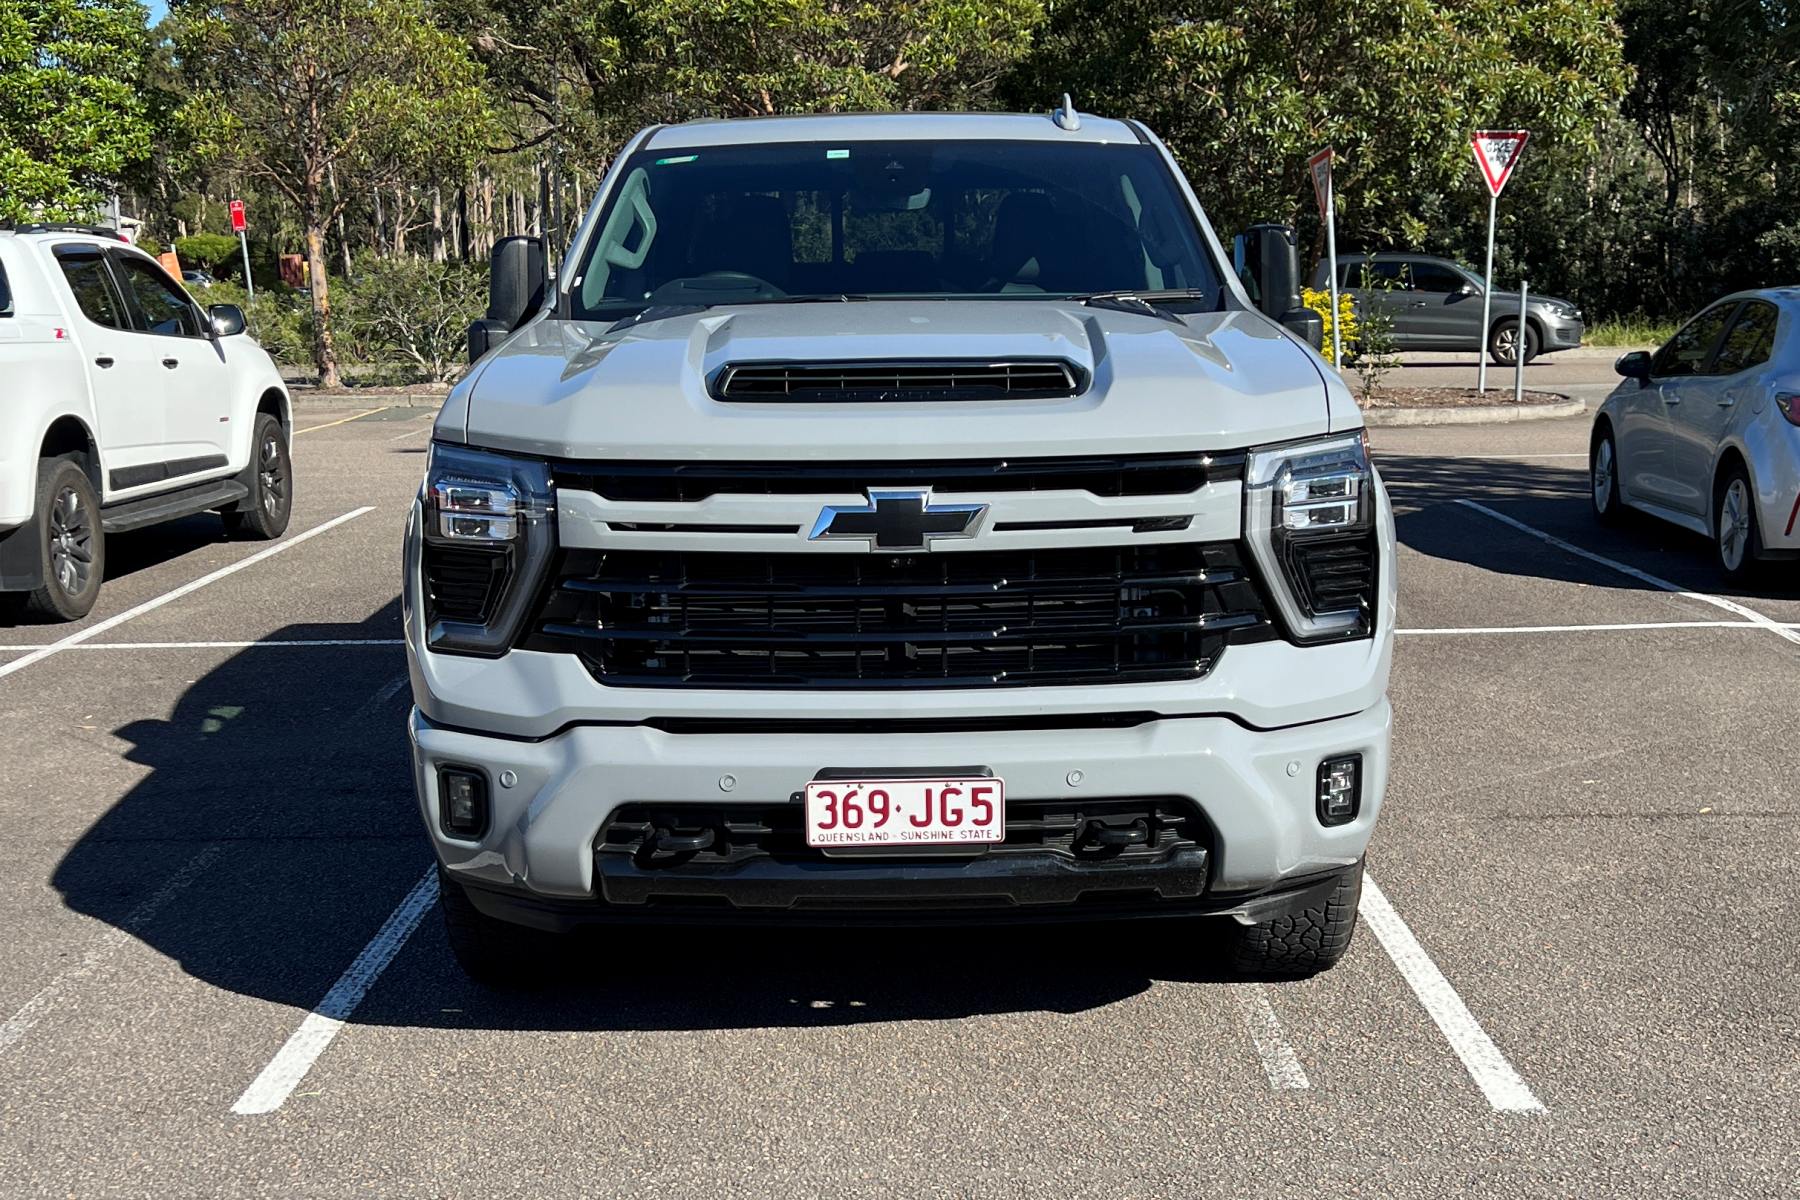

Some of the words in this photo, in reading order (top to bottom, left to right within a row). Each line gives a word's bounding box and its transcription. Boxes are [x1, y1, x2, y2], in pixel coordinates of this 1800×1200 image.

[818, 833, 889, 842] QUEENSLAND
[901, 831, 953, 841] SUNSHINE
[960, 830, 993, 840] STATE
